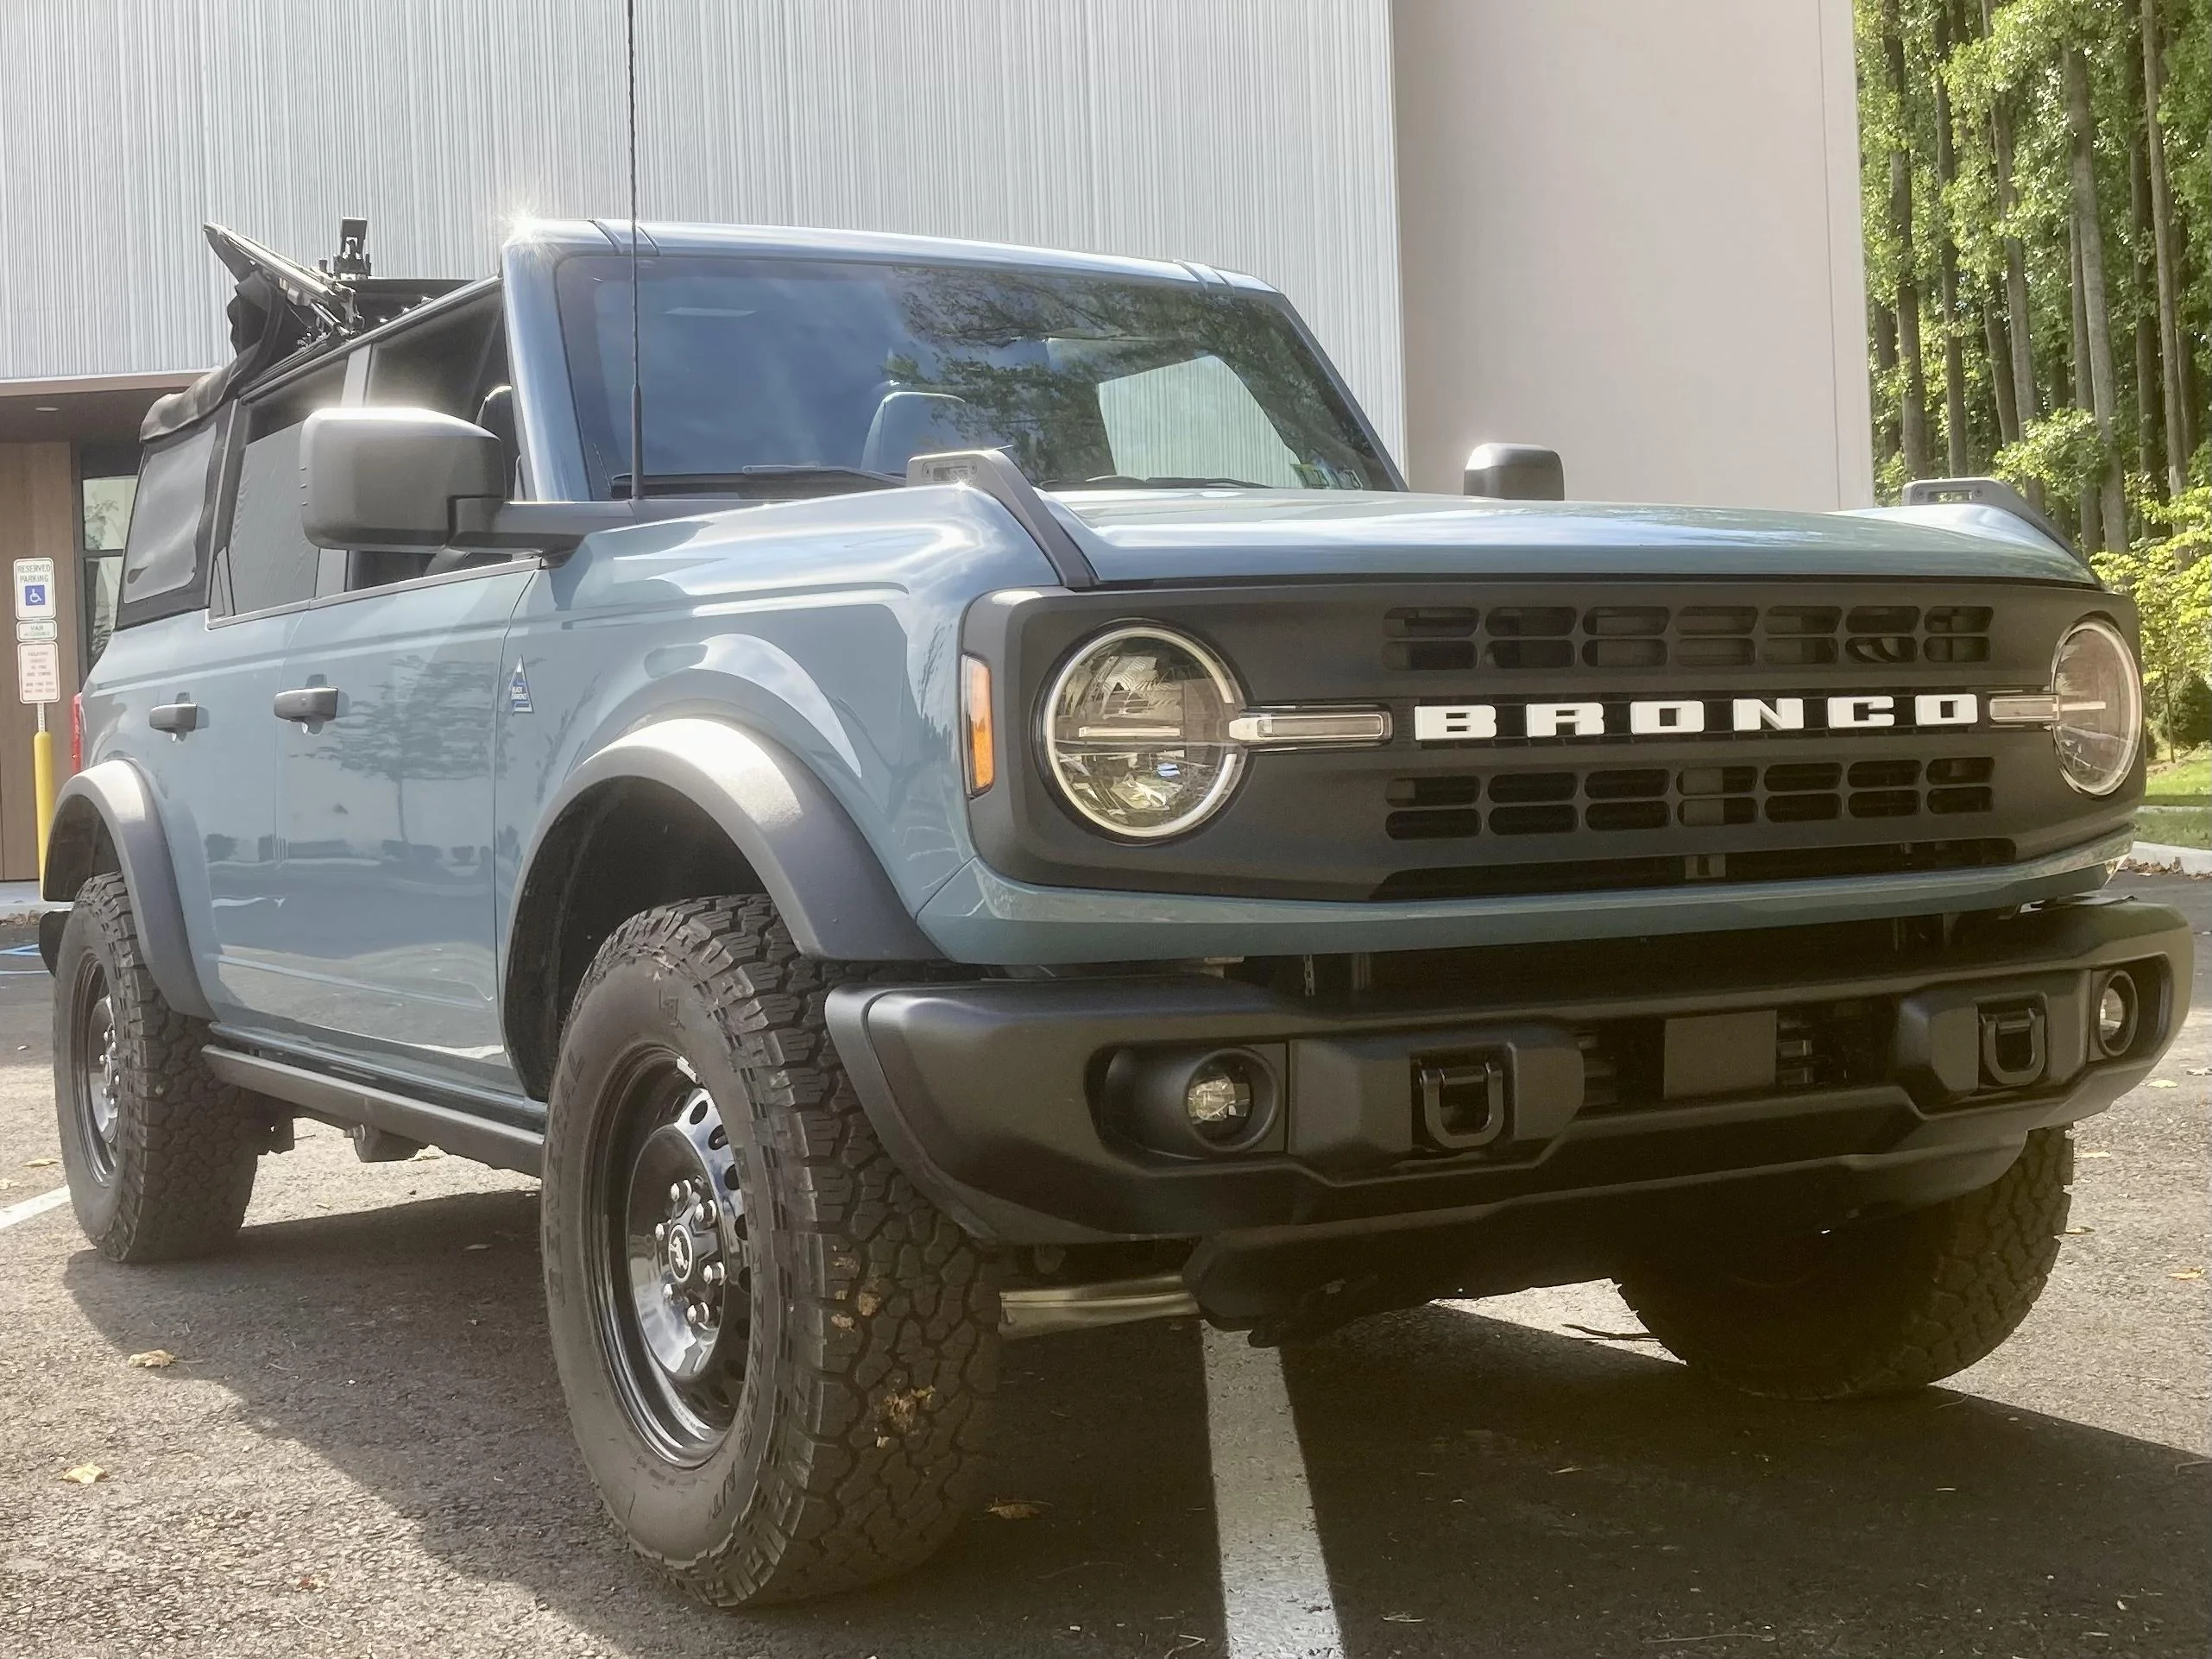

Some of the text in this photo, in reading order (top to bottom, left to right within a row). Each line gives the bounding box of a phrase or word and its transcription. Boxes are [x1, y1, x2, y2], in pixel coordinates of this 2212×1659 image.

[17, 565, 51, 573] RESERVED
[20, 575, 49, 583] PARKING
[1414, 693, 1978, 741] BRONCO
